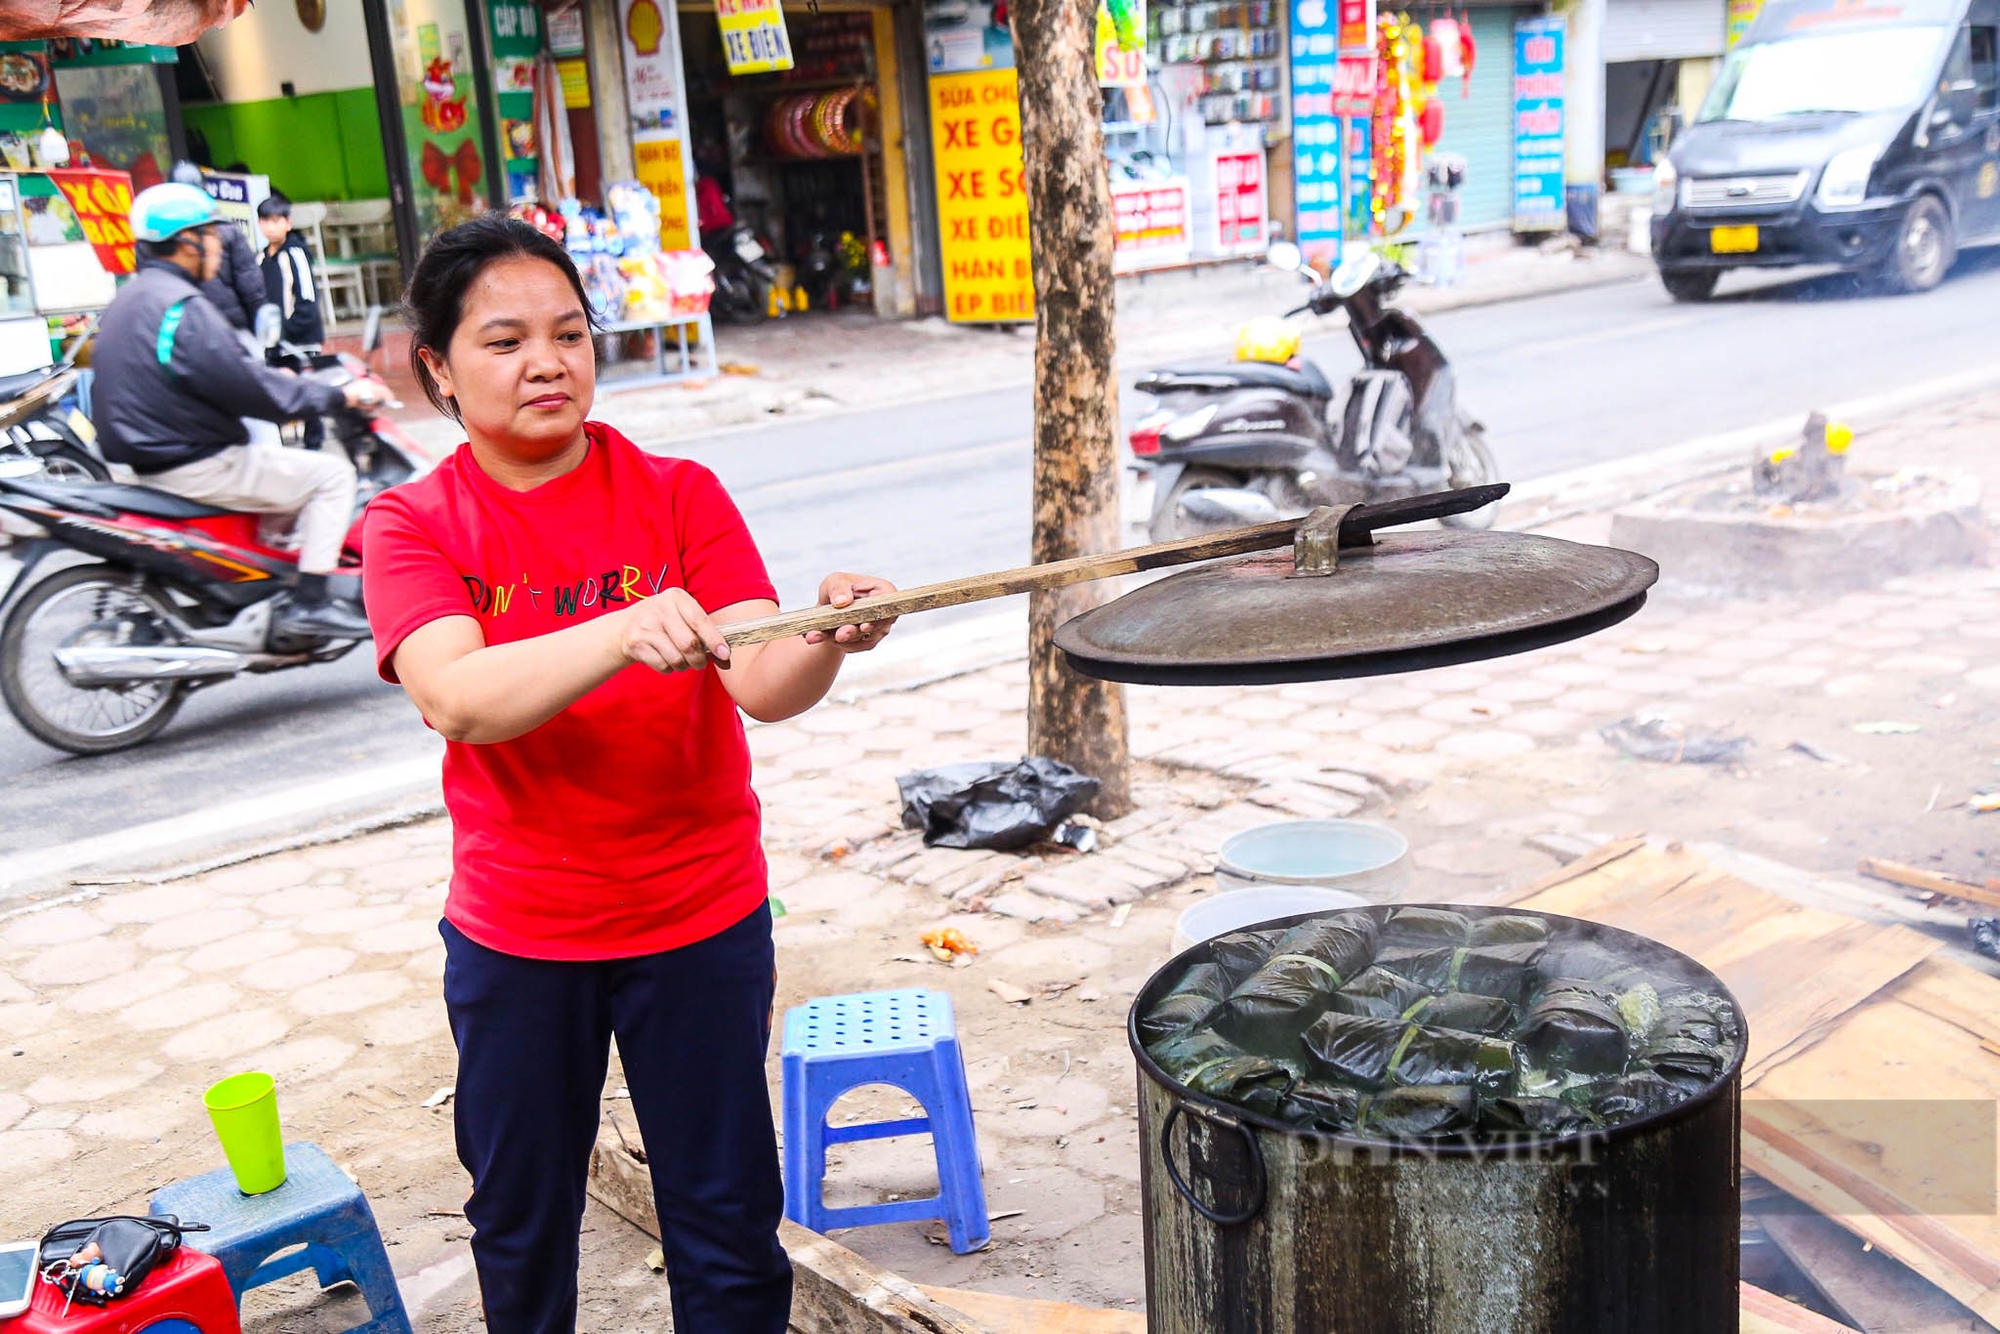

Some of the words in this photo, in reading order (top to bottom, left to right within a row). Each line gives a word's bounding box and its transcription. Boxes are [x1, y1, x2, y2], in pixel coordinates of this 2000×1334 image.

[943, 118, 980, 149] XE
[991, 116, 1023, 147] G
[948, 170, 986, 200] XE
[951, 217, 977, 241] XE
[1014, 257, 1032, 280] B
